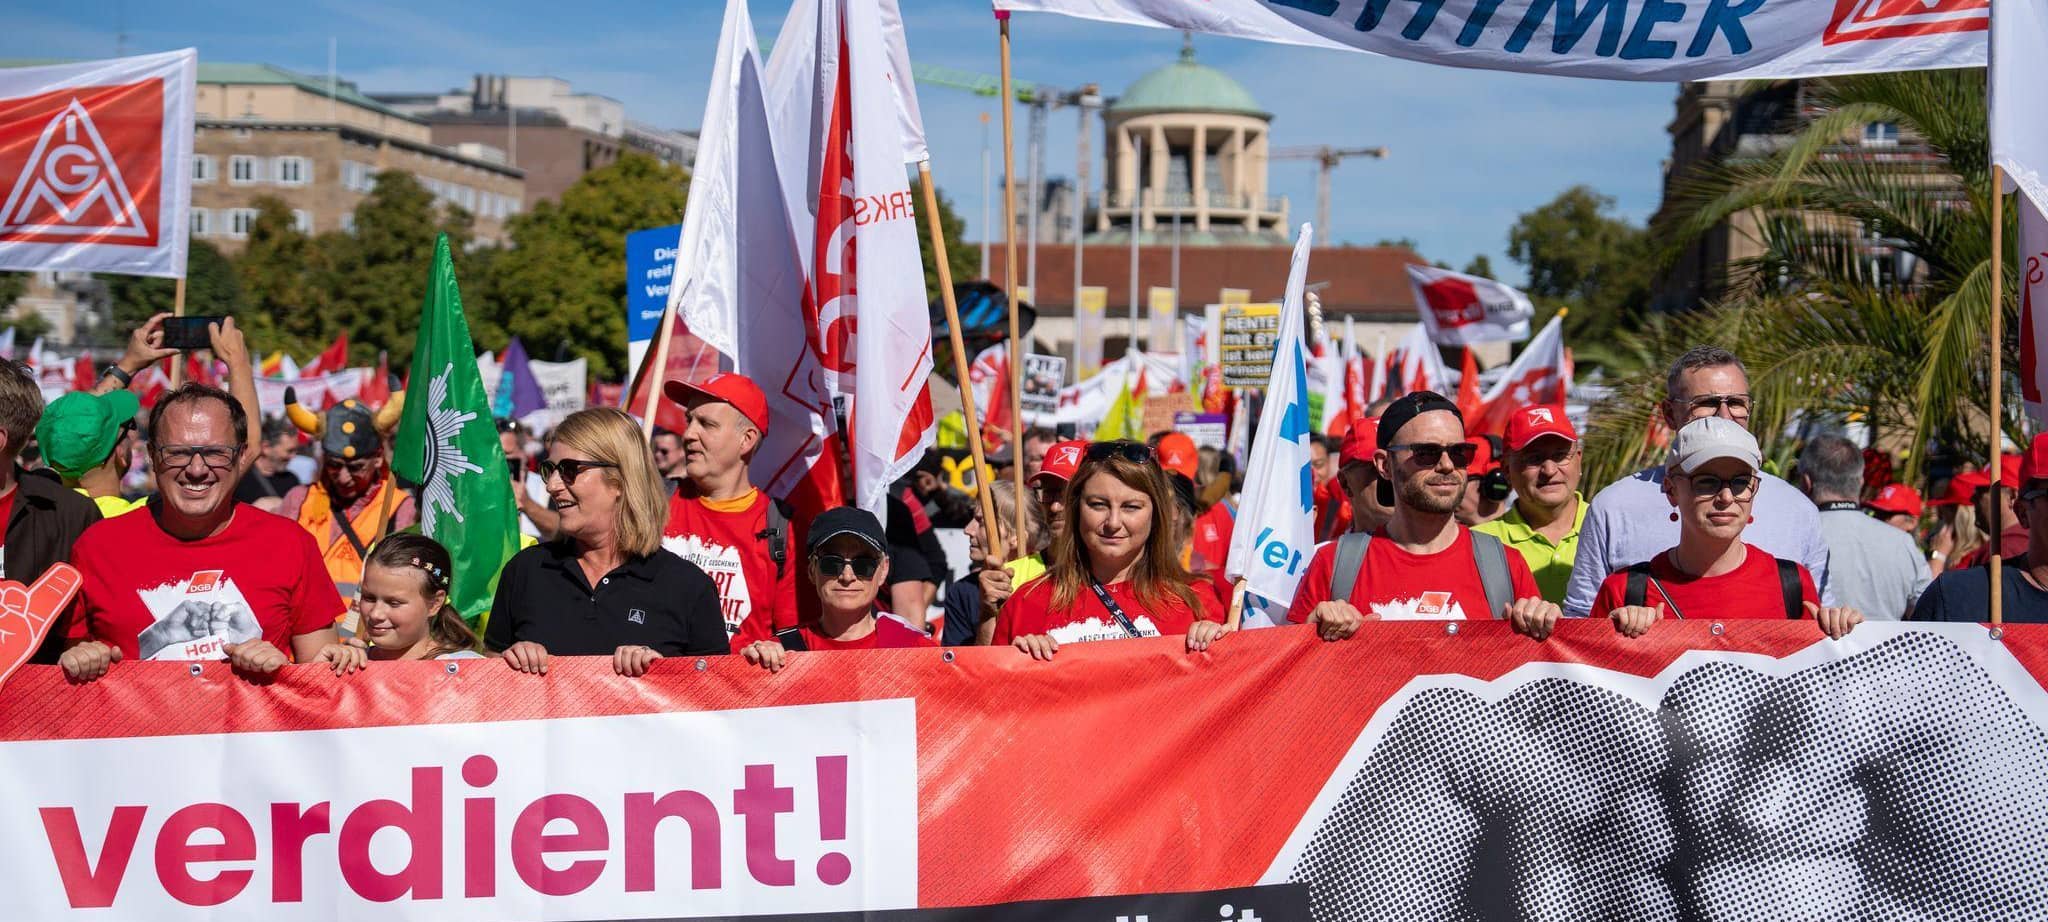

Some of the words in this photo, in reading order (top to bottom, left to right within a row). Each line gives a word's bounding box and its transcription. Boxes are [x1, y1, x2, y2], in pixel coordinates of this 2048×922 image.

[190, 583, 212, 593] DGB
[1419, 604, 1440, 613] DGB
[185, 637, 225, 657] Hart
[38, 753, 851, 908] verdient!
